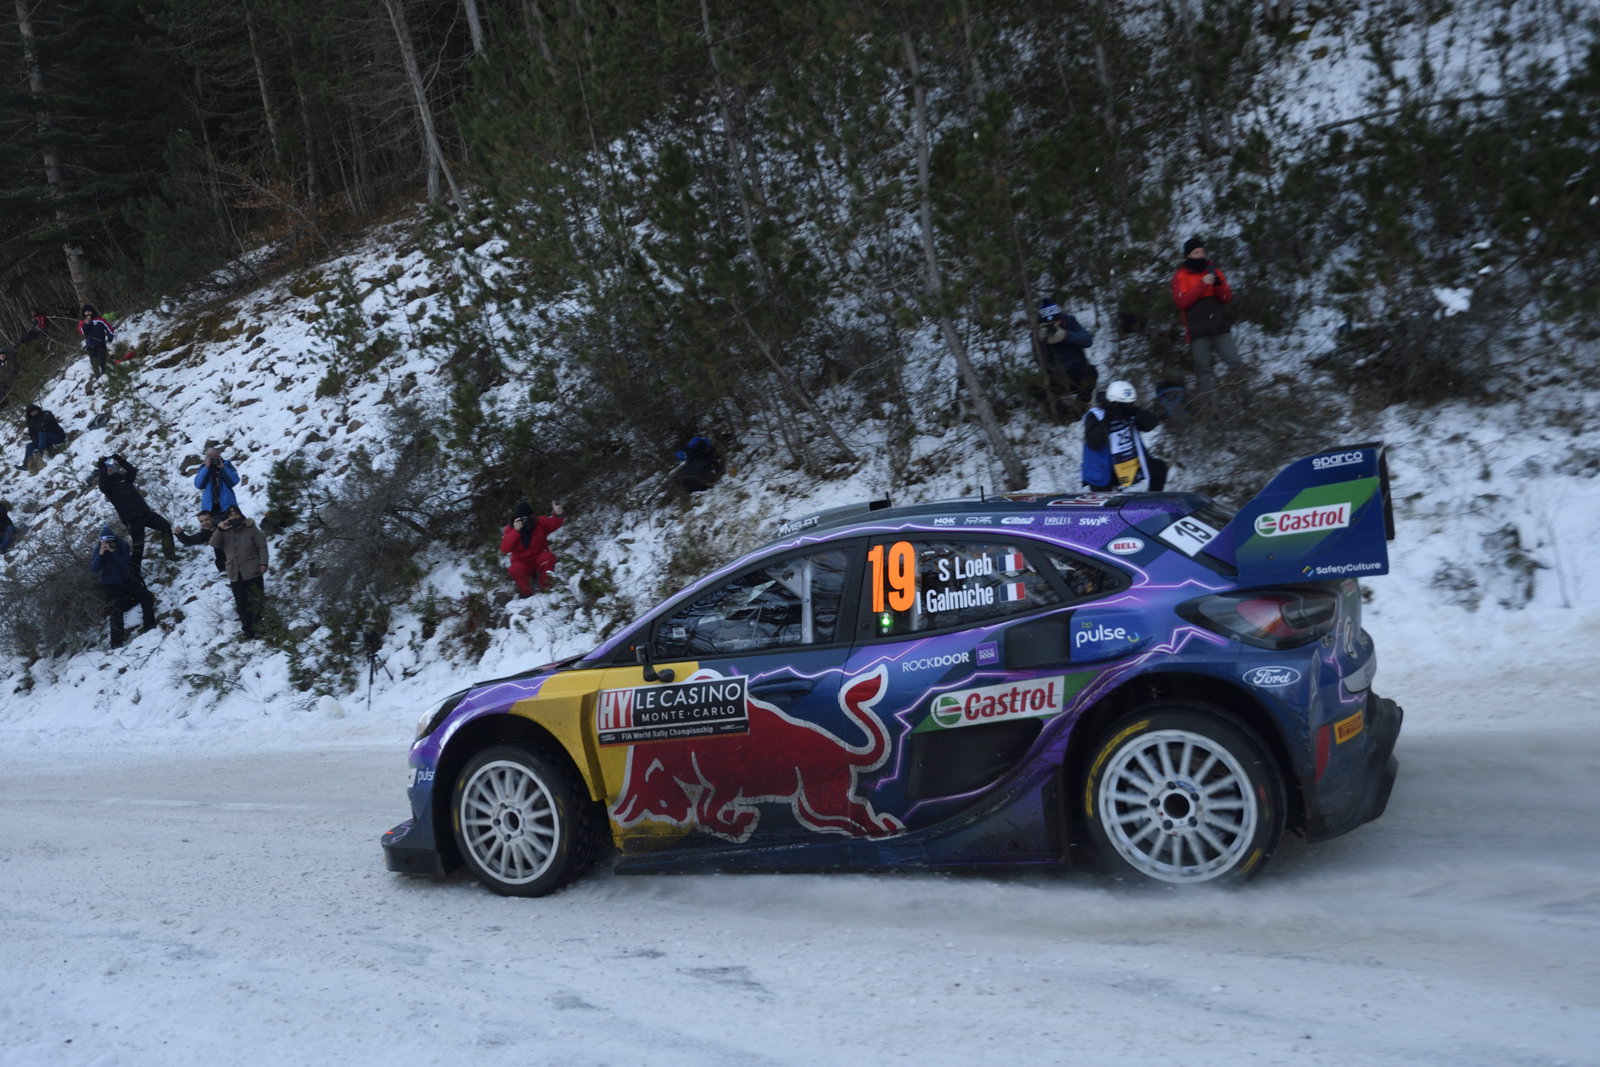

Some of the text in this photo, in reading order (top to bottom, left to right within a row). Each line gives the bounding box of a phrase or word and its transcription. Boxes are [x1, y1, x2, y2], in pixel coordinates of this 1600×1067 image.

[1312, 451, 1363, 469] sparco
[1278, 507, 1344, 532] Castrol
[1174, 521, 1212, 544] 19
[1114, 542, 1137, 550] BELL
[868, 541, 915, 612] 19
[938, 552, 992, 581] S Loeb
[1315, 563, 1381, 574] SafetyCulture
[926, 583, 994, 613] Galmiche
[902, 652, 970, 672] ROCKDOOR
[1253, 669, 1290, 684] Ford
[636, 683, 741, 710] LE CASINO
[964, 682, 1056, 720] Castrol
[601, 690, 632, 729] HY
[633, 731, 651, 739] World
[652, 730, 668, 738] Rally
[669, 726, 714, 736] Championship
